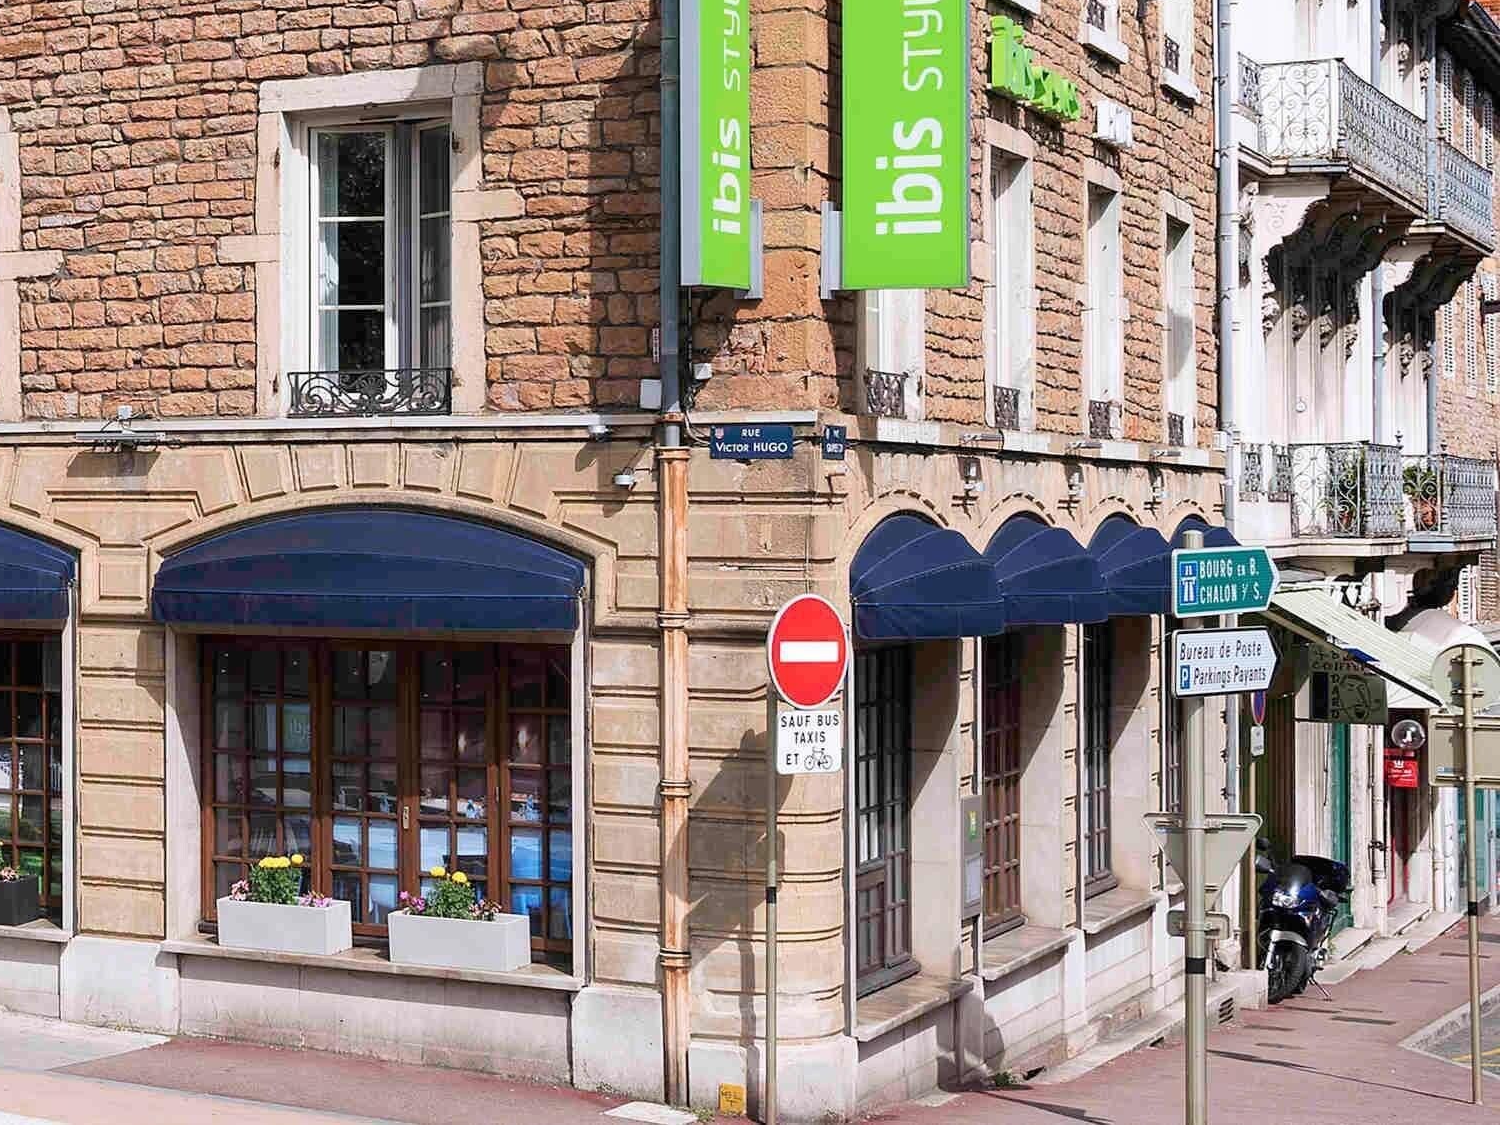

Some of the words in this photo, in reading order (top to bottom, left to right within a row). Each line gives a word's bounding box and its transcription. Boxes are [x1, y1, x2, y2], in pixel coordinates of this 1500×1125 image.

[712, 118, 741, 235] ibis
[876, 117, 943, 235] ibis
[741, 428, 761, 437] RUE
[753, 442, 788, 453] HUGO
[1200, 559, 1232, 579] BOURG
[1200, 584, 1237, 604] CHALON
[1180, 642, 1214, 660] Bureau
[1219, 639, 1231, 658] de
[1235, 639, 1261, 658] Poste
[1194, 666, 1232, 686] Parkings
[1233, 665, 1267, 685] Payants
[781, 715, 811, 727] SAUF
[817, 714, 839, 726] BUS
[794, 731, 826, 744] TAXIS
[786, 753, 799, 765] ET
